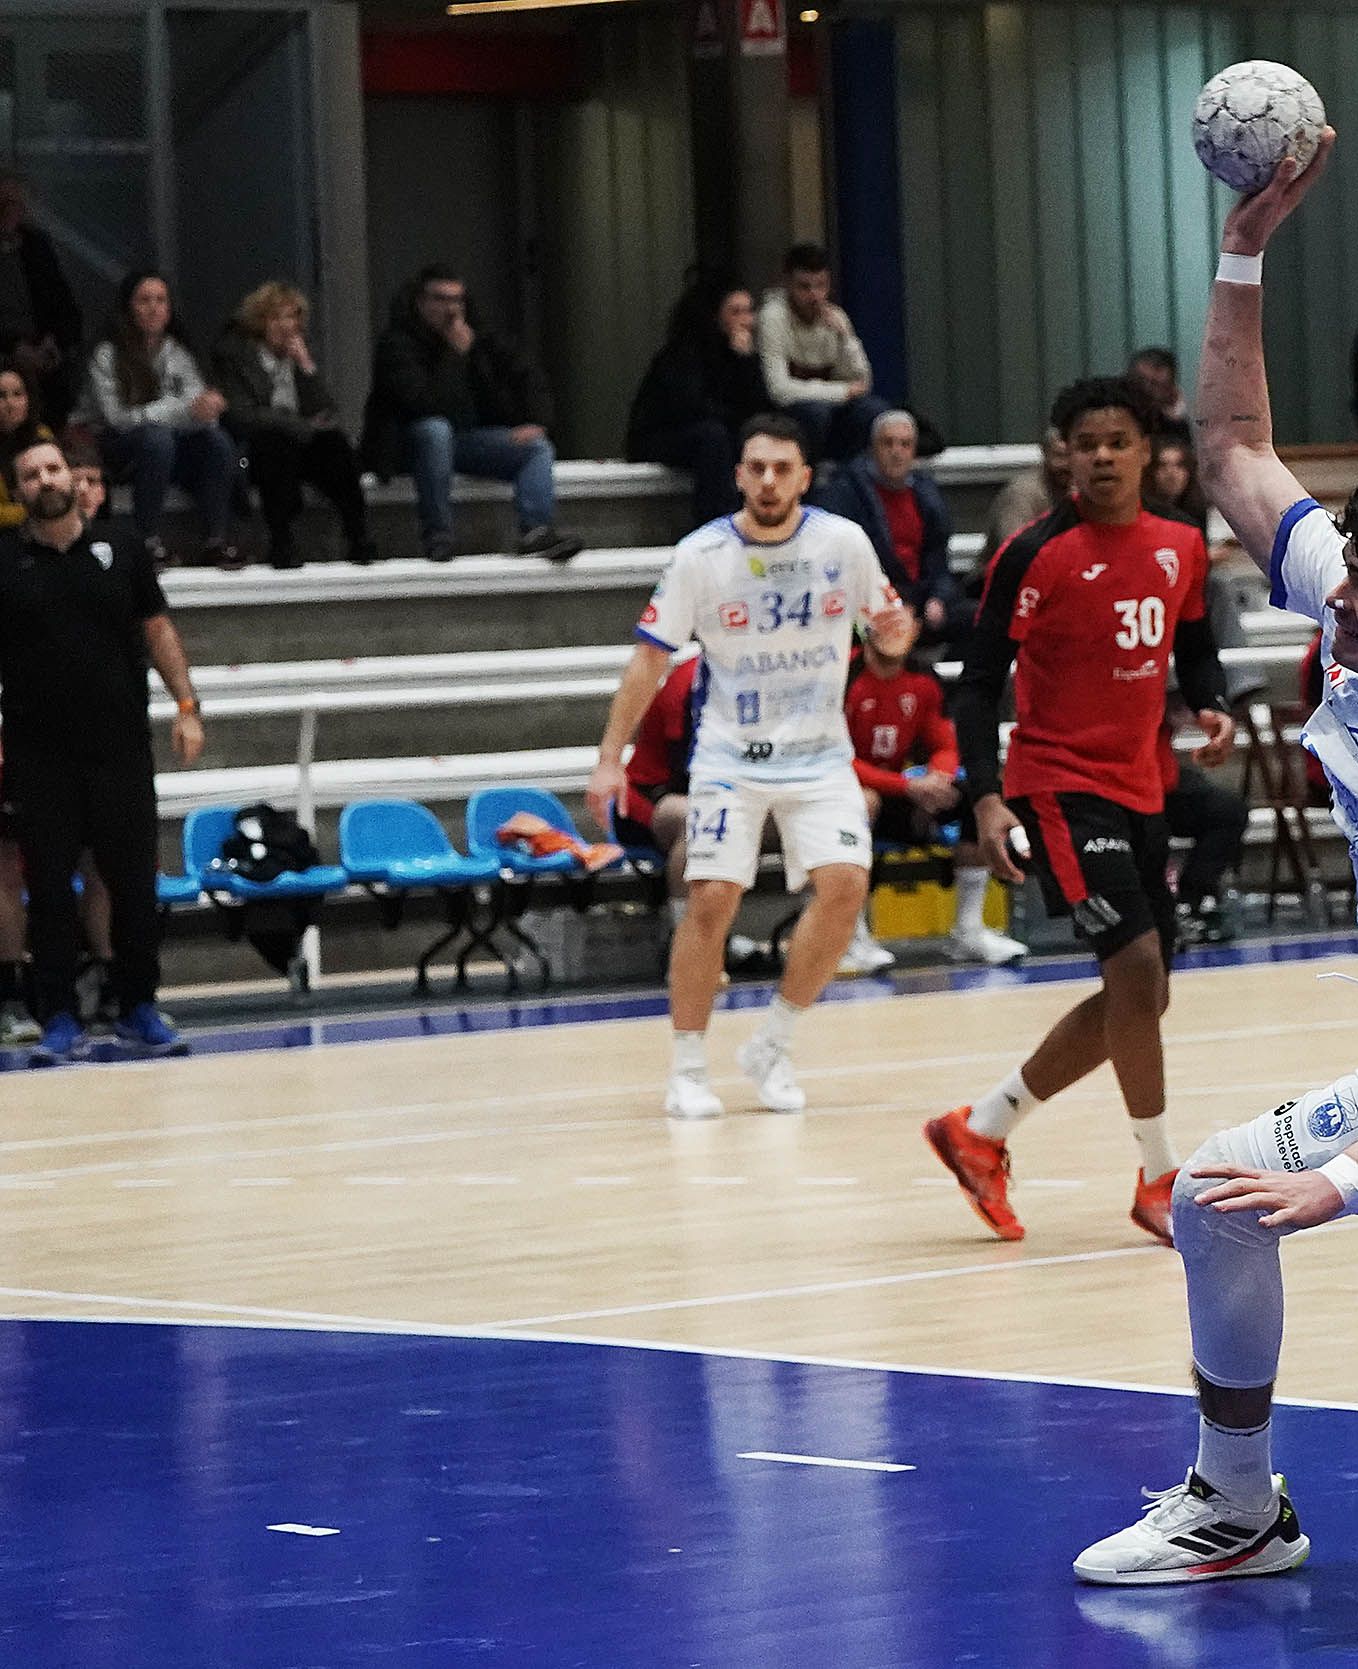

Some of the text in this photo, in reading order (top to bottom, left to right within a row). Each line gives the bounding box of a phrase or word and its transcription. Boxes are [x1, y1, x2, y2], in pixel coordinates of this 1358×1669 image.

[757, 590, 813, 634] 34
[1113, 596, 1165, 650] 30
[1273, 1119, 1295, 1174] Ponteve
